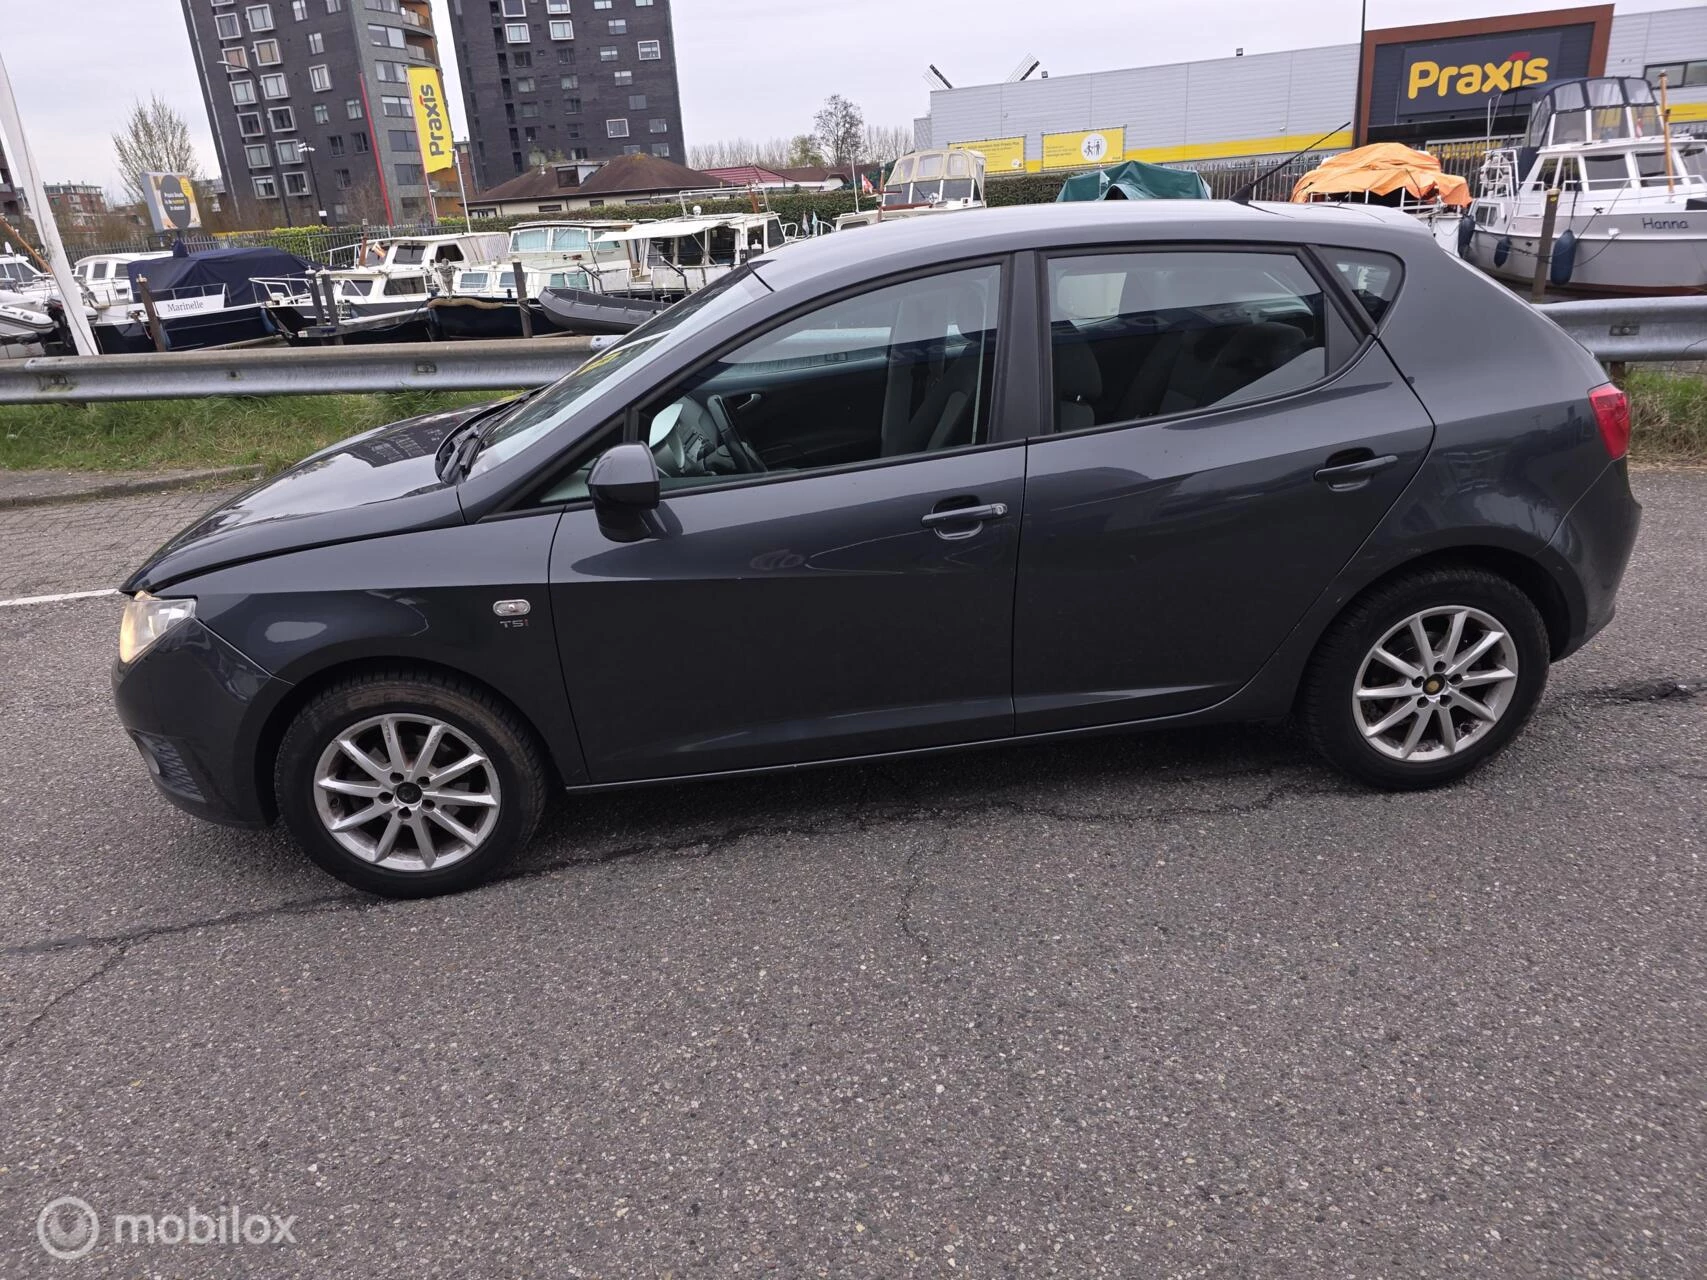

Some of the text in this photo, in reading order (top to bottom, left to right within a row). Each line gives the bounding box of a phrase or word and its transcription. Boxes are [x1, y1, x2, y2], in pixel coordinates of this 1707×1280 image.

[1407, 51, 1549, 99] Praxis
[419, 84, 445, 157] Praxis
[1641, 217, 1689, 230] Hanna
[167, 300, 204, 312] Marinelle
